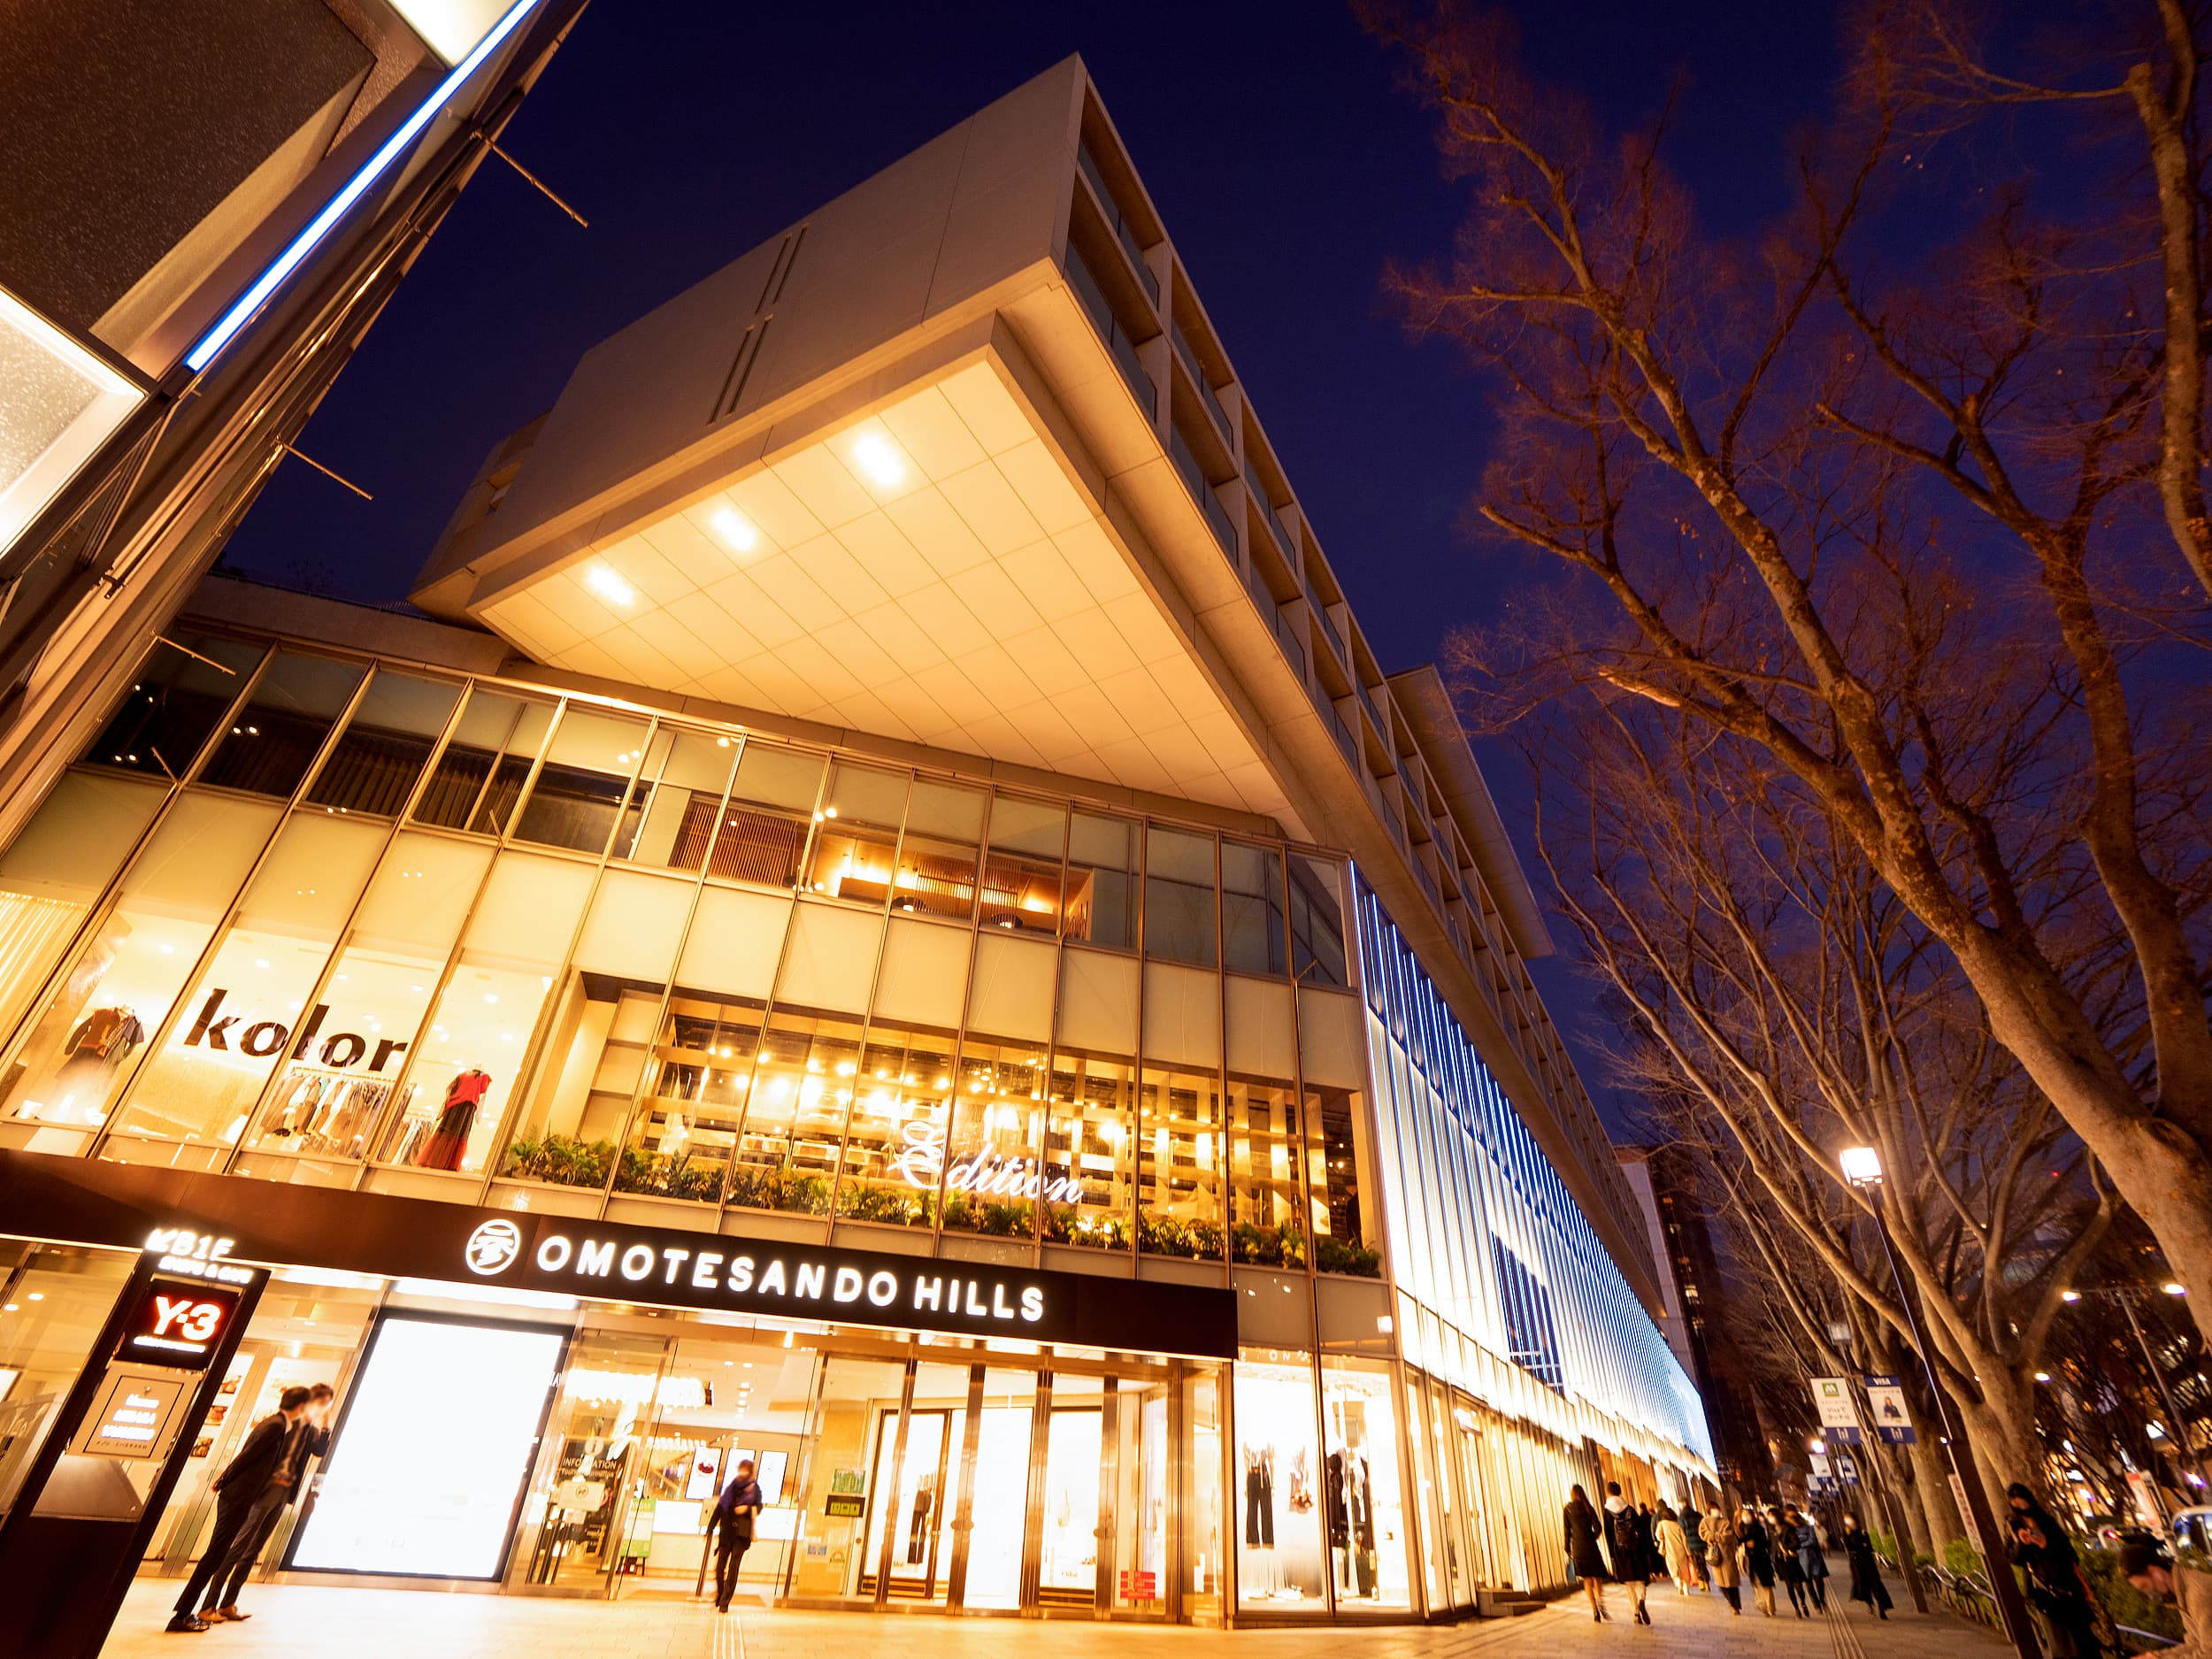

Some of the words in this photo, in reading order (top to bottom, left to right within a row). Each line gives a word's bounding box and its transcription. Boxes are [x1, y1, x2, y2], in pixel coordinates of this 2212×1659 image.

[183, 987, 409, 1072] kolor
[886, 1121, 1083, 1204] Edition
[153, 1295, 221, 1340] Y-3
[537, 1235, 897, 1307] OMOTESANDO
[914, 1275, 1043, 1321] HILLS
[562, 1457, 618, 1470] INFOATION
